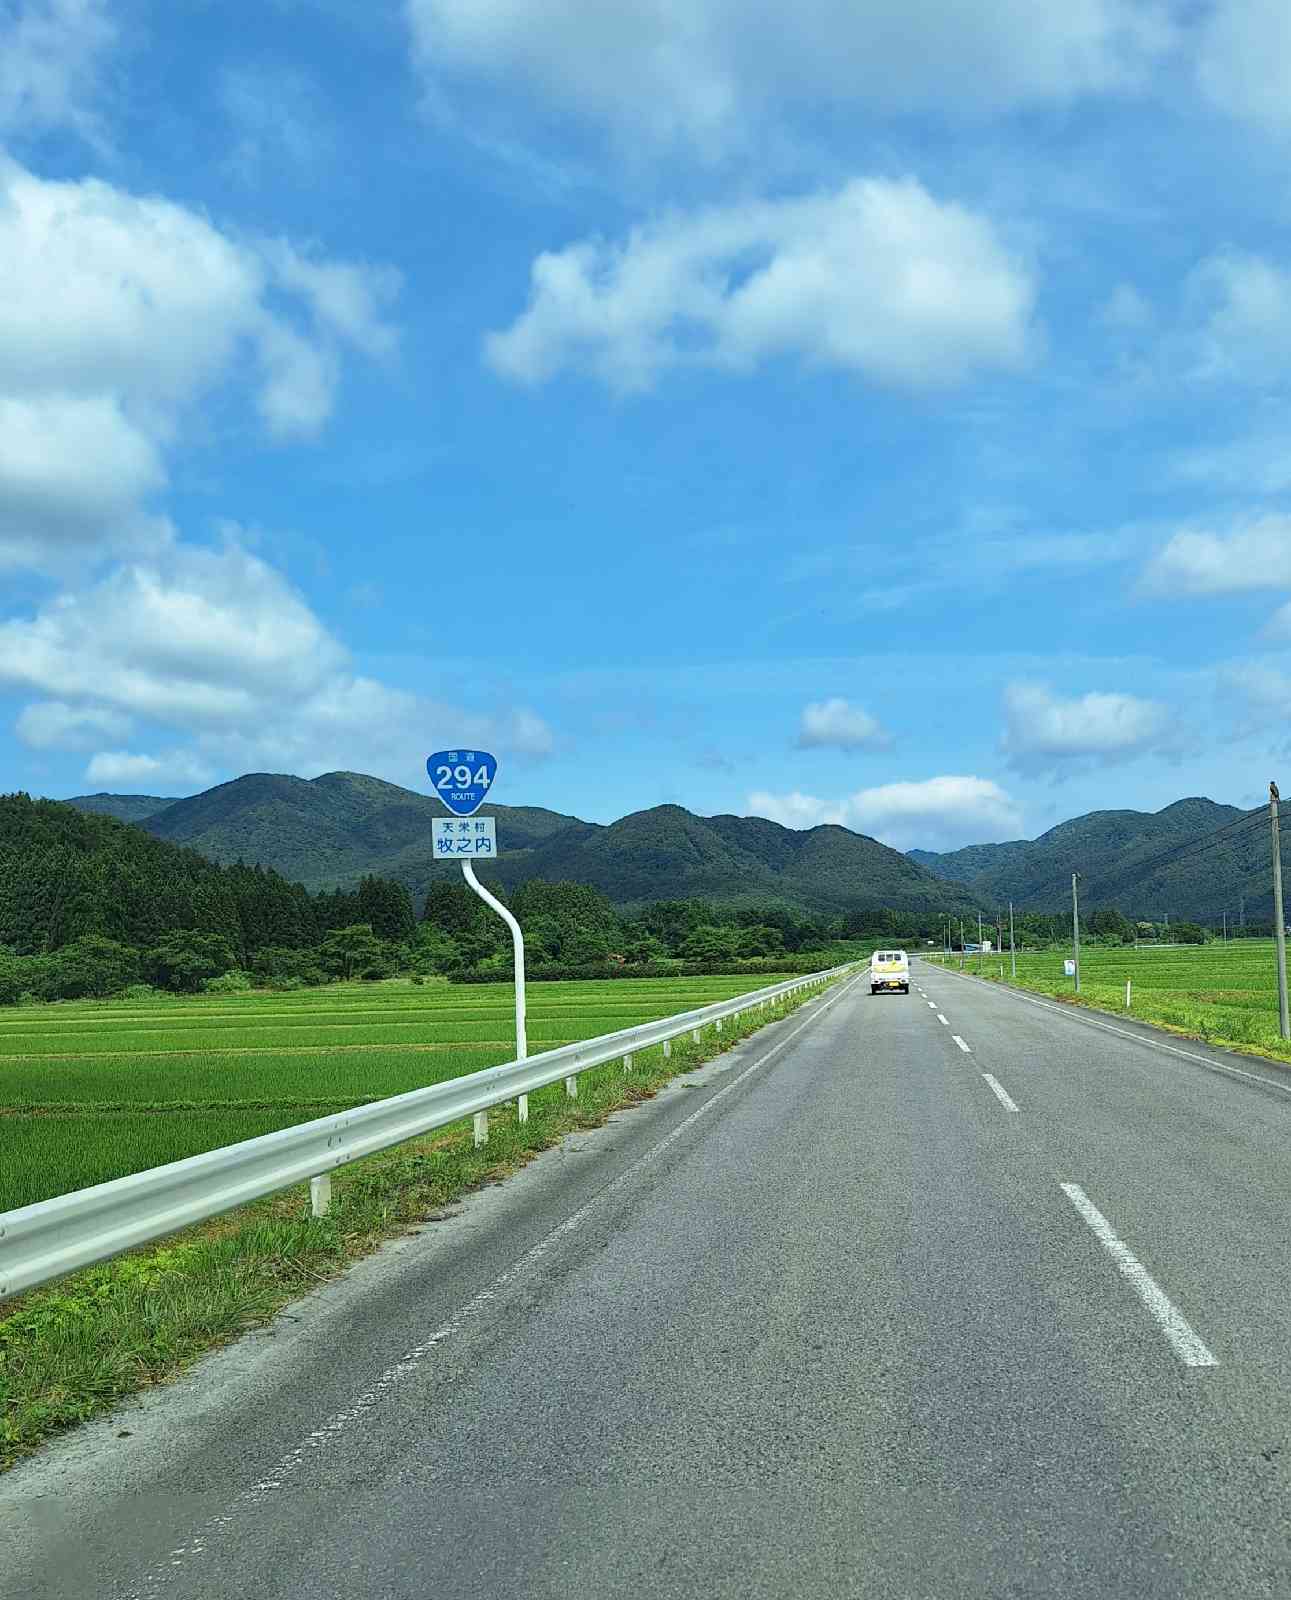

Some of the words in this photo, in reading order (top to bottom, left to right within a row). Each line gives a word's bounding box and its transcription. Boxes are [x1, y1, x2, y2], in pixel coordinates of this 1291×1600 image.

[436, 765, 490, 789] 294
[451, 792, 476, 800] ROUTE
[437, 837, 491, 853] 牧之内
